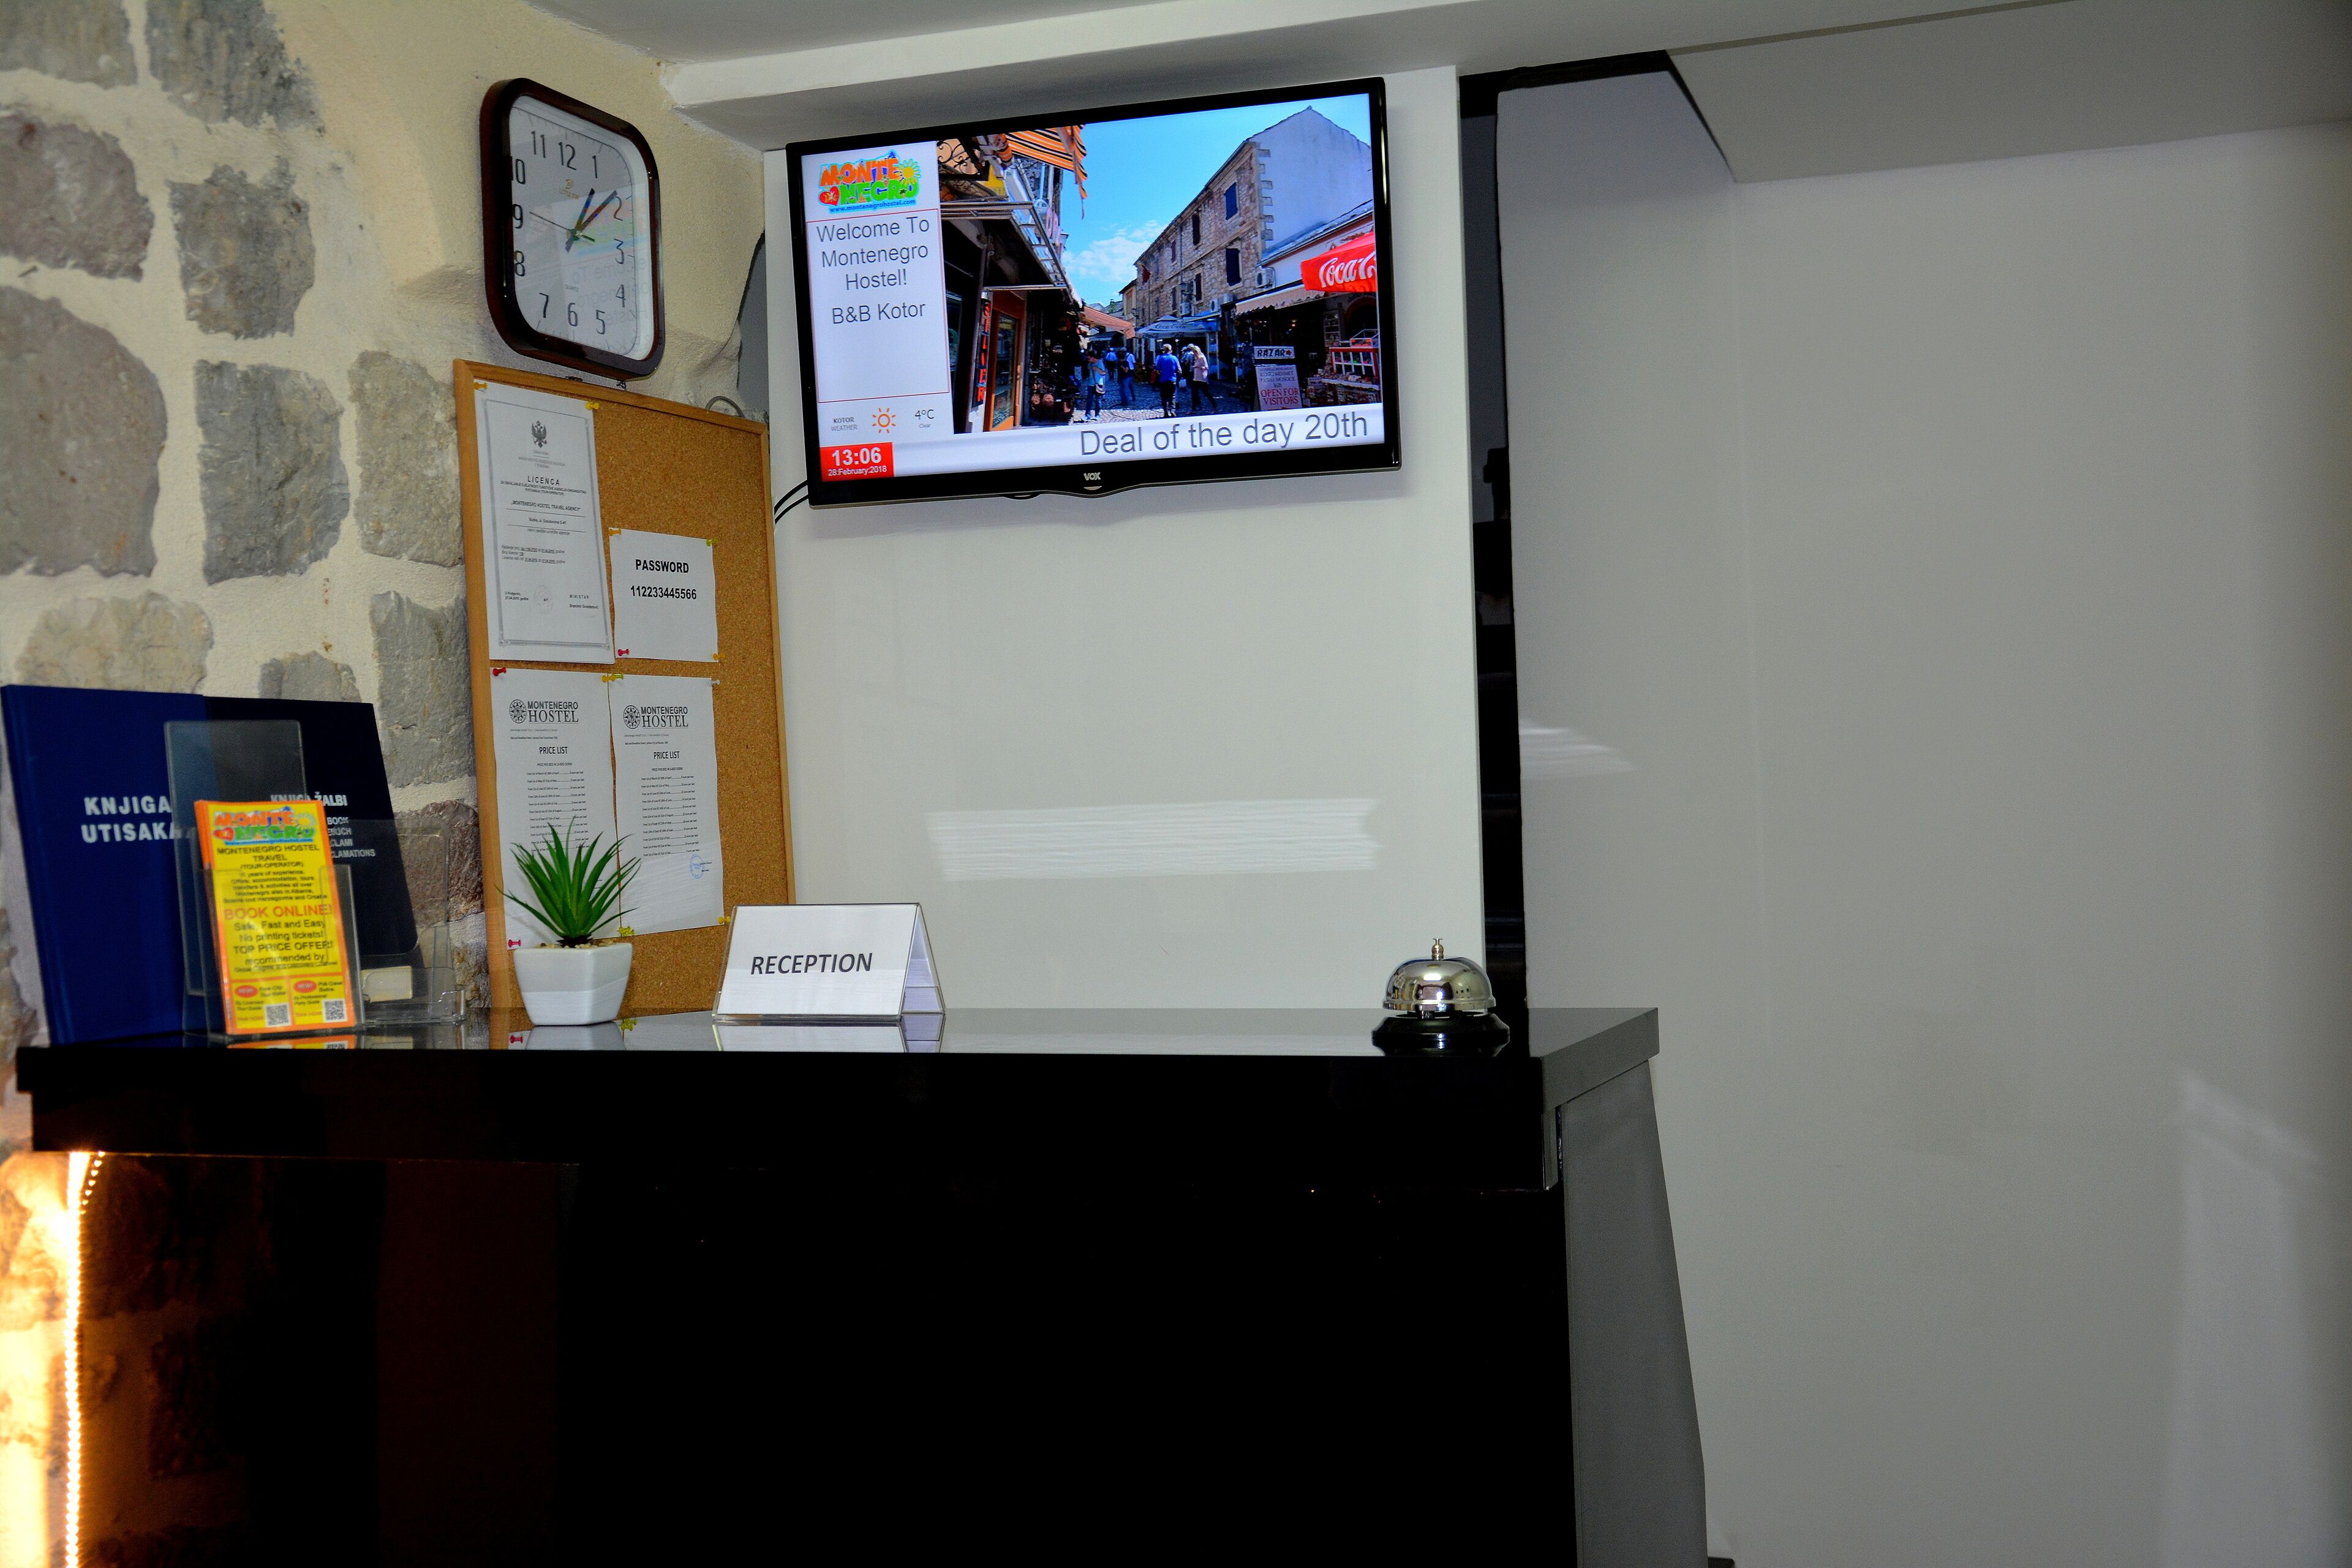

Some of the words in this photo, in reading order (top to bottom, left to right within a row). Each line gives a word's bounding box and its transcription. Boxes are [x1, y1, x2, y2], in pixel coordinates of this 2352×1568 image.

[531, 130, 546, 158] 11
[558, 142, 577, 170] 12
[592, 156, 598, 178] 1
[820, 157, 899, 187] MONTE
[840, 179, 919, 205] NEGRO
[613, 195, 623, 221] 2
[829, 199, 916, 213] www.montenegrohostel.com
[512, 204, 523, 229] 9
[816, 222, 900, 243] Welcome
[906, 216, 930, 233] To
[614, 238, 624, 264] 3
[821, 245, 929, 268] Montenegro
[514, 250, 526, 277] 8
[846, 268, 907, 290] Hostel!
[539, 293, 549, 318] 7
[616, 284, 626, 308] 4
[568, 303, 578, 327] 6
[596, 309, 605, 335] 5
[832, 305, 871, 324] B&B
[878, 302, 926, 320] Kotor
[1257, 349, 1286, 357] BAZAR
[1261, 389, 1282, 398] OPEN
[1283, 388, 1299, 396] FOR
[1262, 396, 1299, 405] VISITORS
[914, 409, 935, 420] 4°C
[1080, 426, 1142, 456] Deal
[1154, 424, 1180, 450] of
[1188, 422, 1232, 448] the
[1243, 418, 1294, 448] day
[1305, 411, 1368, 440] 20th
[832, 447, 882, 466] 13:06
[527, 475, 560, 486] LICENCA
[1084, 472, 1101, 481] VOX
[635, 559, 689, 573] PASSWORD
[630, 585, 697, 600] 112233445566
[527, 701, 579, 710] MONTENEGRO
[641, 706, 688, 715] MONTENEGRO
[528, 710, 579, 723] HOSTEL
[642, 715, 689, 728] HOSTEL
[84, 796, 172, 816] KNJIGA
[214, 811, 295, 826] MONTE
[81, 822, 182, 843] UTISAKA
[217, 846, 282, 854] MONTENEGRO
[224, 907, 269, 921] BOOK
[273, 904, 333, 919] ONLINE!
[262, 921, 282, 929] Fast
[284, 919, 301, 928] and
[304, 919, 325, 930] Easy
[256, 932, 290, 942] printing
[292, 929, 323, 939] tickets!
[233, 945, 254, 954] TOP
[258, 943, 292, 953] PRICE
[294, 941, 333, 950] OFFER!
[245, 953, 311, 965] recommended
[314, 952, 325, 962] by
[750, 952, 873, 975] RECEPTION
